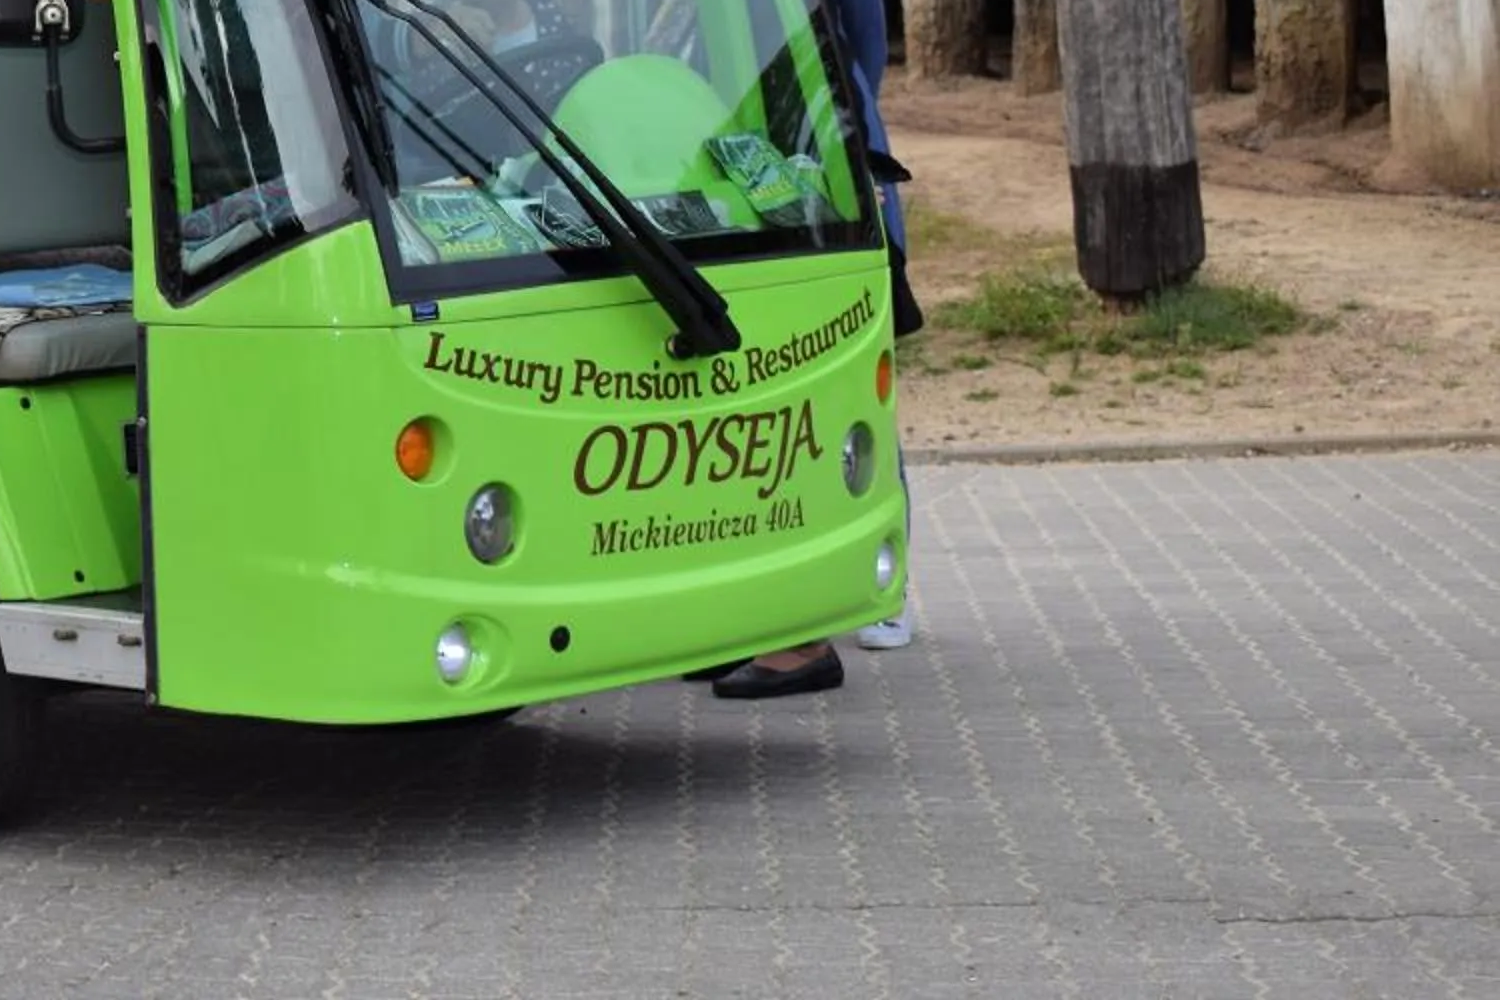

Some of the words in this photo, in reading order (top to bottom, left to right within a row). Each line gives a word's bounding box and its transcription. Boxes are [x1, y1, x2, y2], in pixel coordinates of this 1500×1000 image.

[424, 331, 563, 404] Luxury
[571, 359, 703, 401] Pension
[711, 357, 741, 396] &
[744, 284, 875, 387] Restaurant
[573, 398, 824, 499] ODYSEJA
[590, 508, 759, 556] Mickiewicza
[765, 497, 805, 533] 40A
